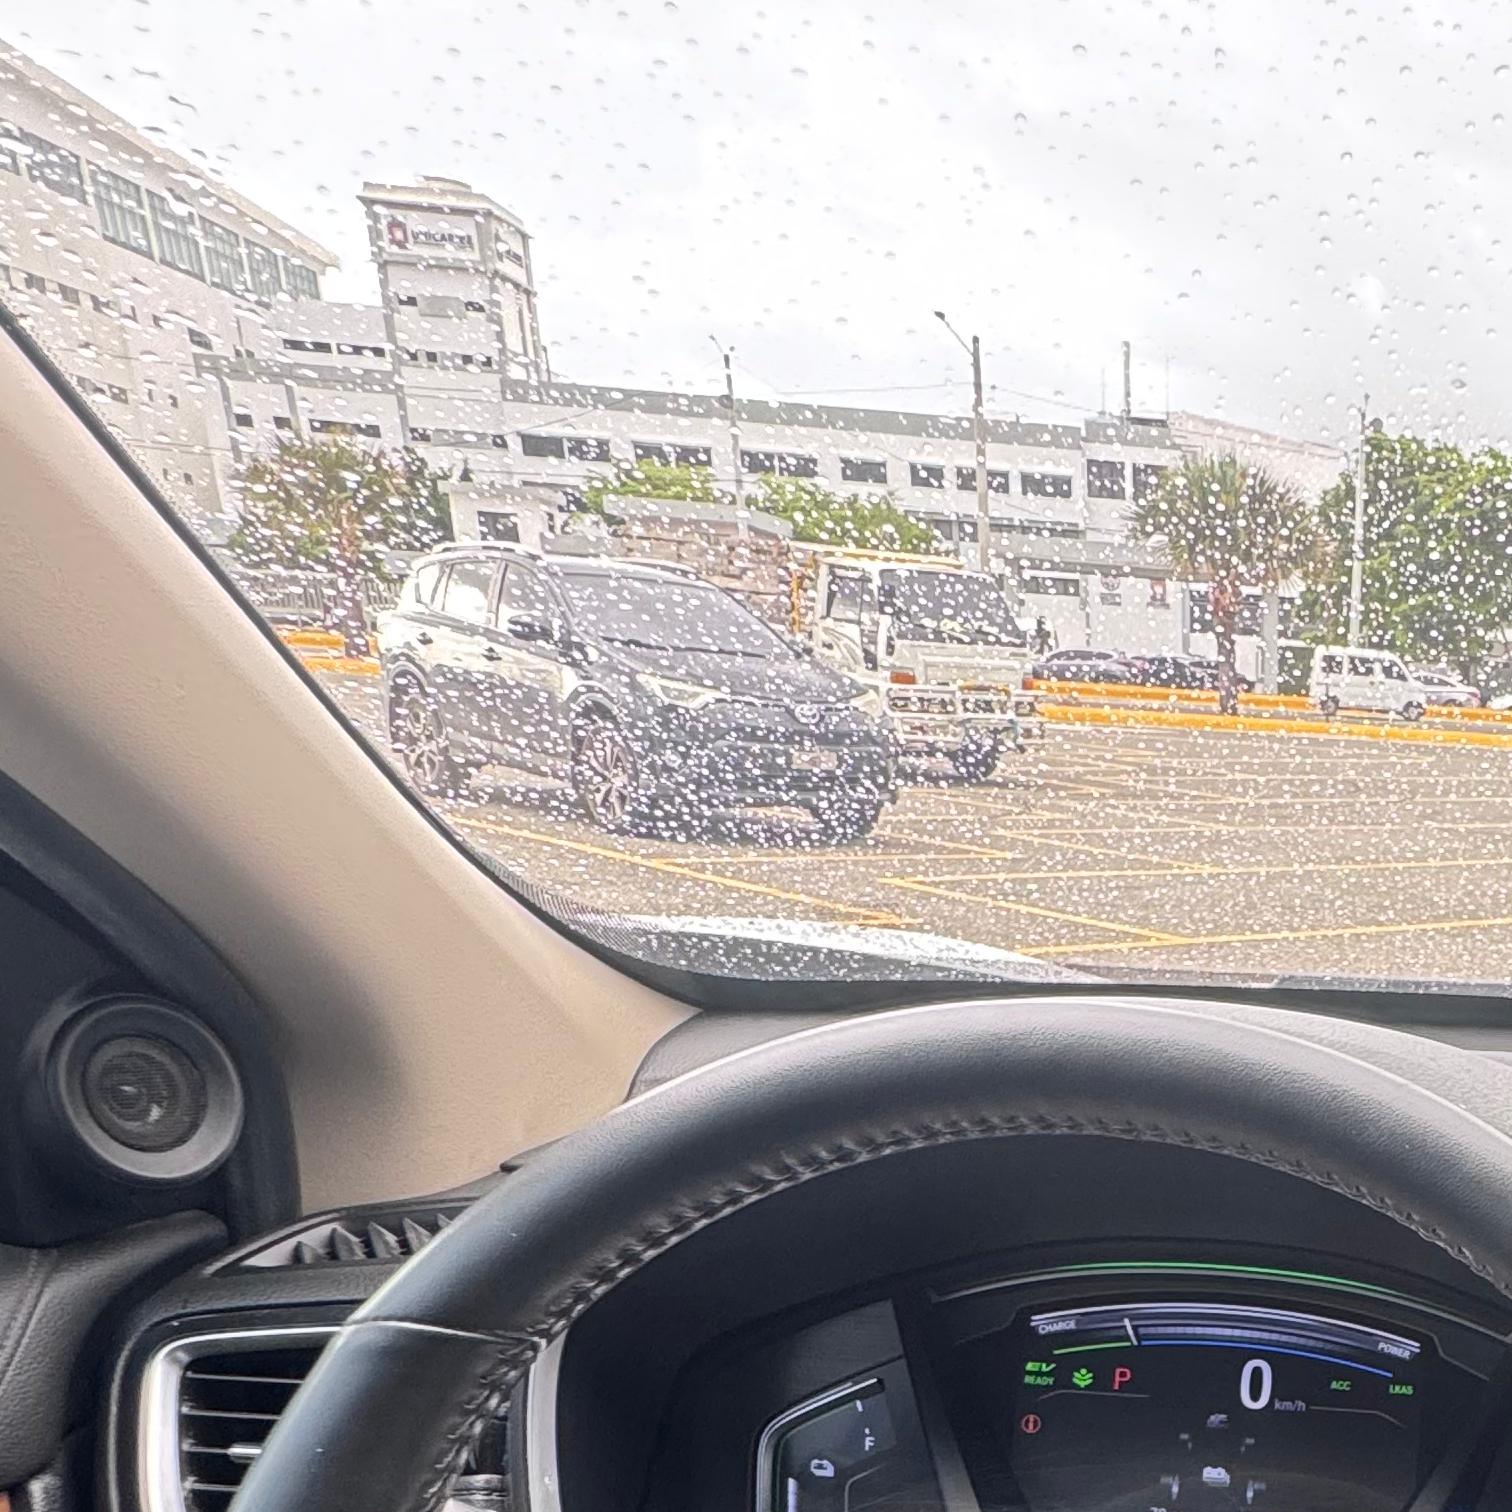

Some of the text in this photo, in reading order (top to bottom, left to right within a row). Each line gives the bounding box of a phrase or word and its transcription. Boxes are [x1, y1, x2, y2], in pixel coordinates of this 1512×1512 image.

[1037, 1319, 1077, 1334] CHARGE
[1377, 1342, 1411, 1360] POWER
[1023, 1375, 1054, 1386] READY
[1112, 1367, 1132, 1391] P
[1239, 1358, 1306, 1411] 0 km/h
[1329, 1381, 1351, 1391] ACC
[864, 1436, 876, 1451] F
